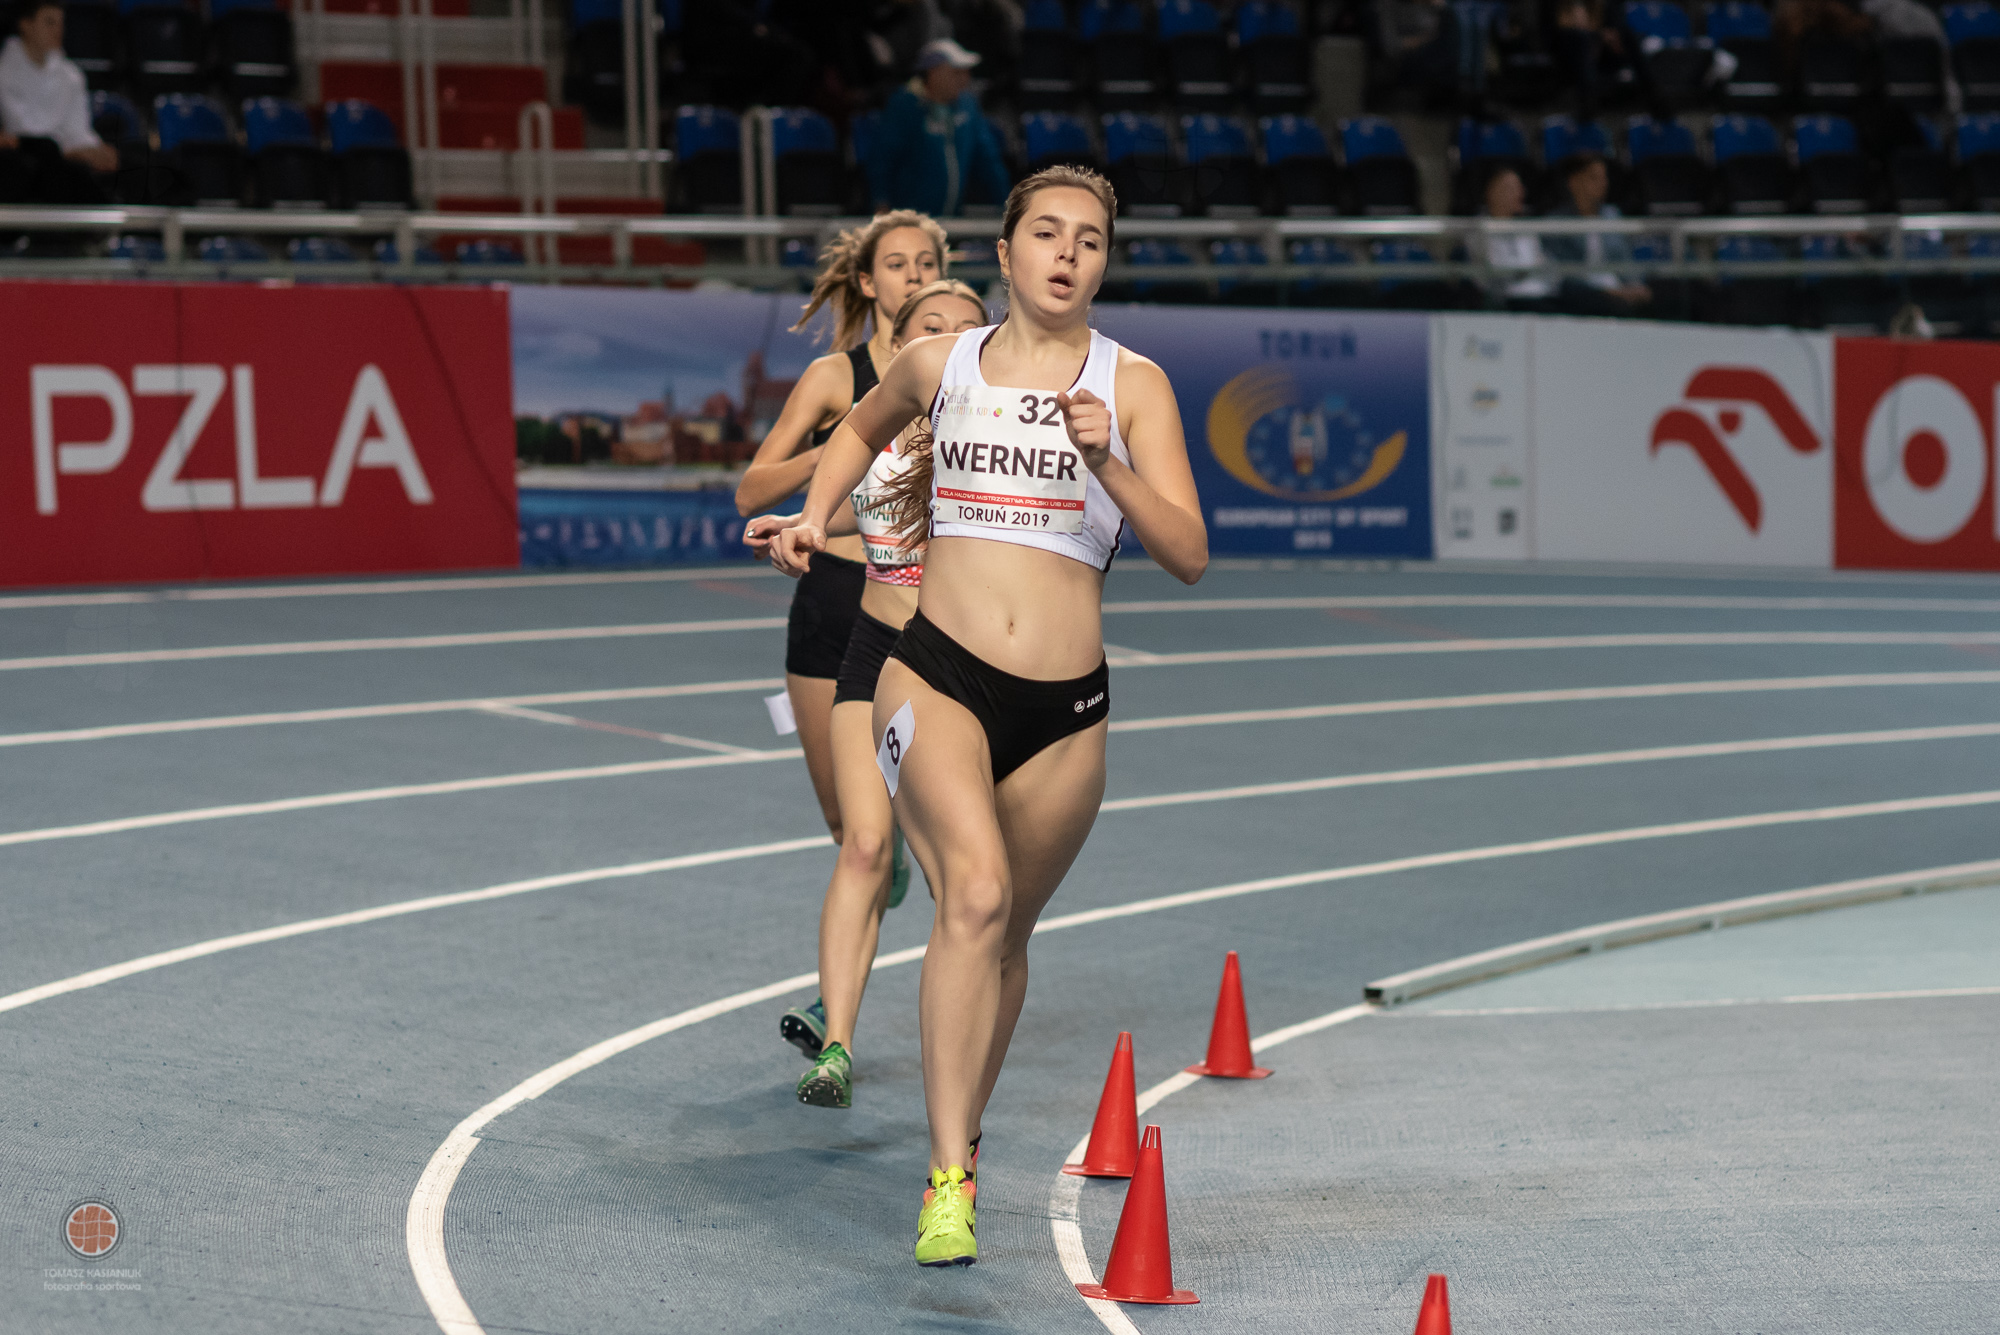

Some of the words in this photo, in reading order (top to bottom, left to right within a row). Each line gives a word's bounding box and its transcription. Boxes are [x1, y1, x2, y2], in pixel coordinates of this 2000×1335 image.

[1018, 394, 1061, 427] 32
[31, 364, 434, 515] PZLA
[940, 440, 1078, 481] WERNER
[1861, 374, 2000, 545] O
[940, 489, 954, 497] PZLA
[954, 491, 975, 500] HALOWE
[976, 494, 1024, 504] MISTRZOSTWA
[958, 505, 1006, 524] TORUŃ
[1011, 511, 1050, 528] 2019
[1086, 691, 1104, 708] JAKO
[886, 726, 901, 766] 8
